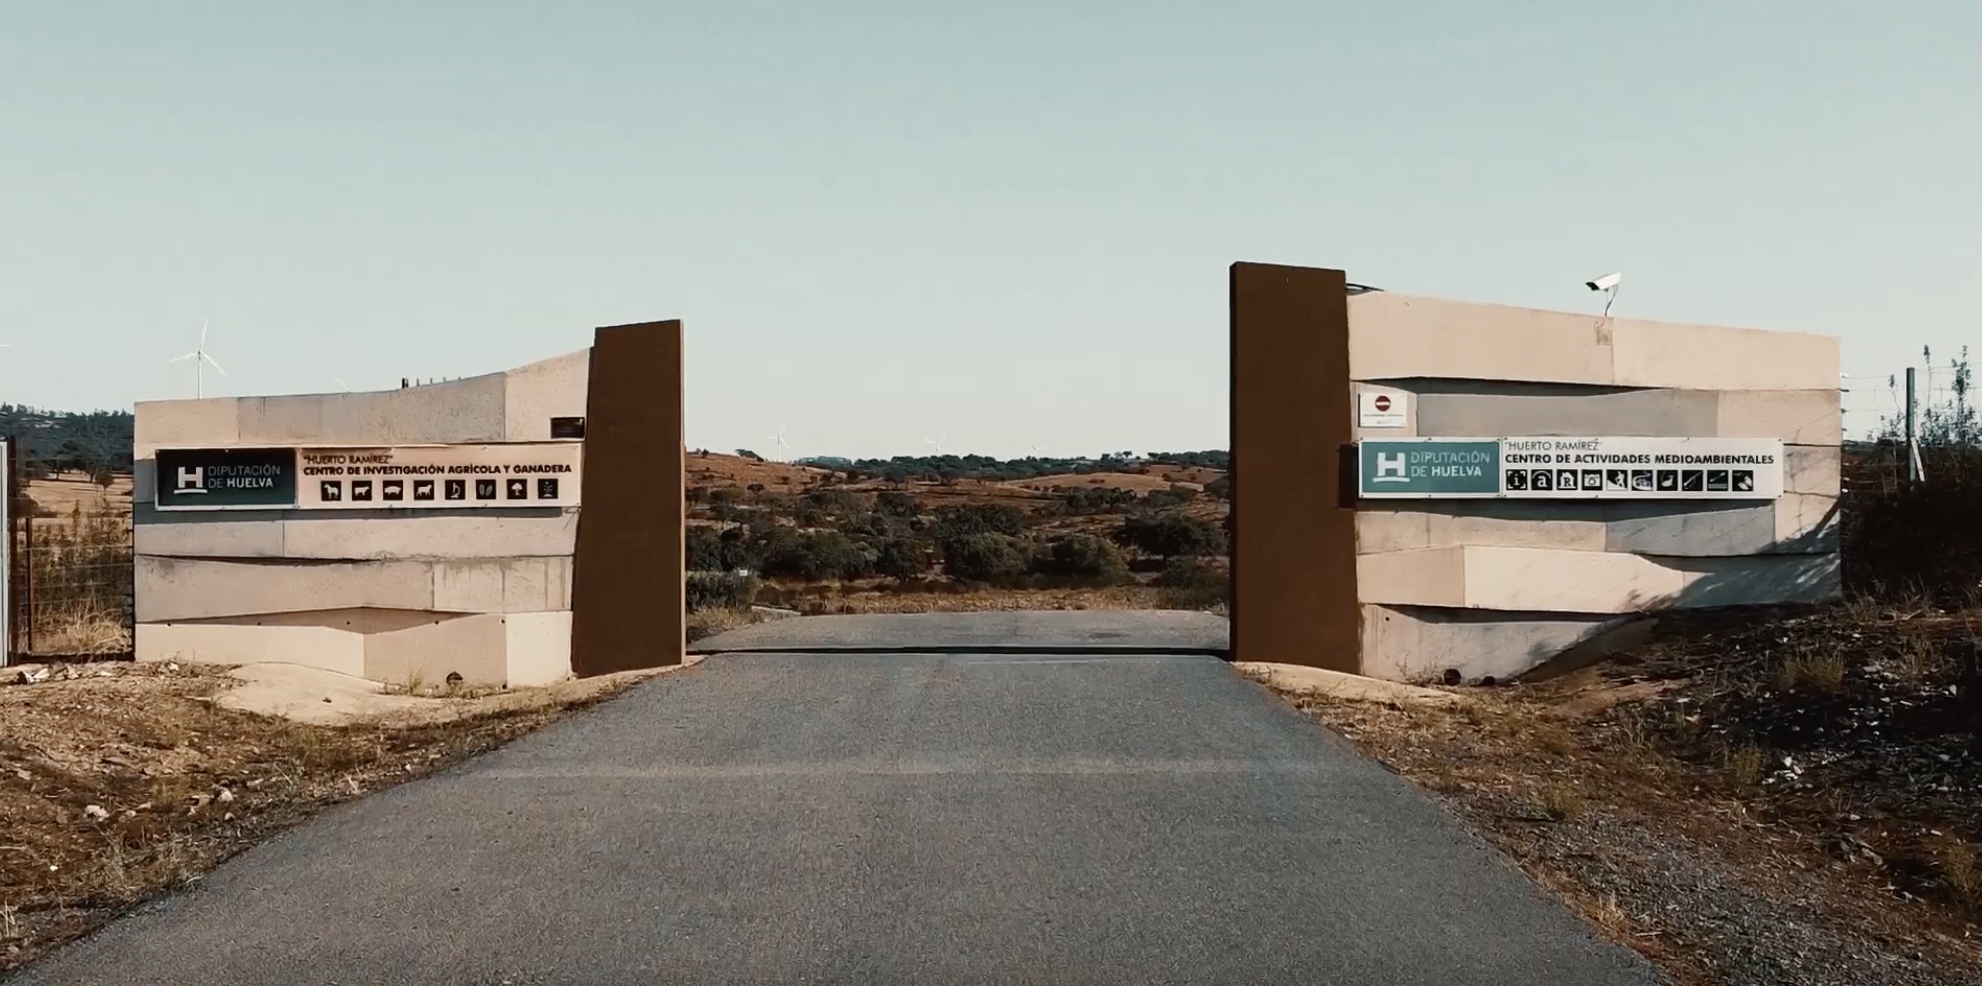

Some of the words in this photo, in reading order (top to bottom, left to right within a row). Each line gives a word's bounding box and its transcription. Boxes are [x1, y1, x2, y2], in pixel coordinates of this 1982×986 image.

[1411, 450, 1490, 464] DIPUTACIÓN
[1505, 454, 1552, 464] CENTRO
[1555, 454, 1571, 464] DE
[1574, 454, 1651, 464] ACTIVIDADES
[1654, 454, 1775, 465] MEDIOAMBIENTALES
[208, 464, 281, 476] DIPUTACIÓN
[303, 466, 344, 476] CENTRO
[347, 466, 361, 475] DE
[363, 463, 445, 475] INVESTIGACIÓN
[448, 463, 501, 474] AGRÍCOLA
[504, 464, 512, 474] Y
[515, 464, 572, 474] GANADERA
[1411, 466, 1427, 477] DE
[1431, 466, 1482, 477] HUELVA
[208, 478, 224, 488] DE
[227, 477, 274, 488] HUELVA
